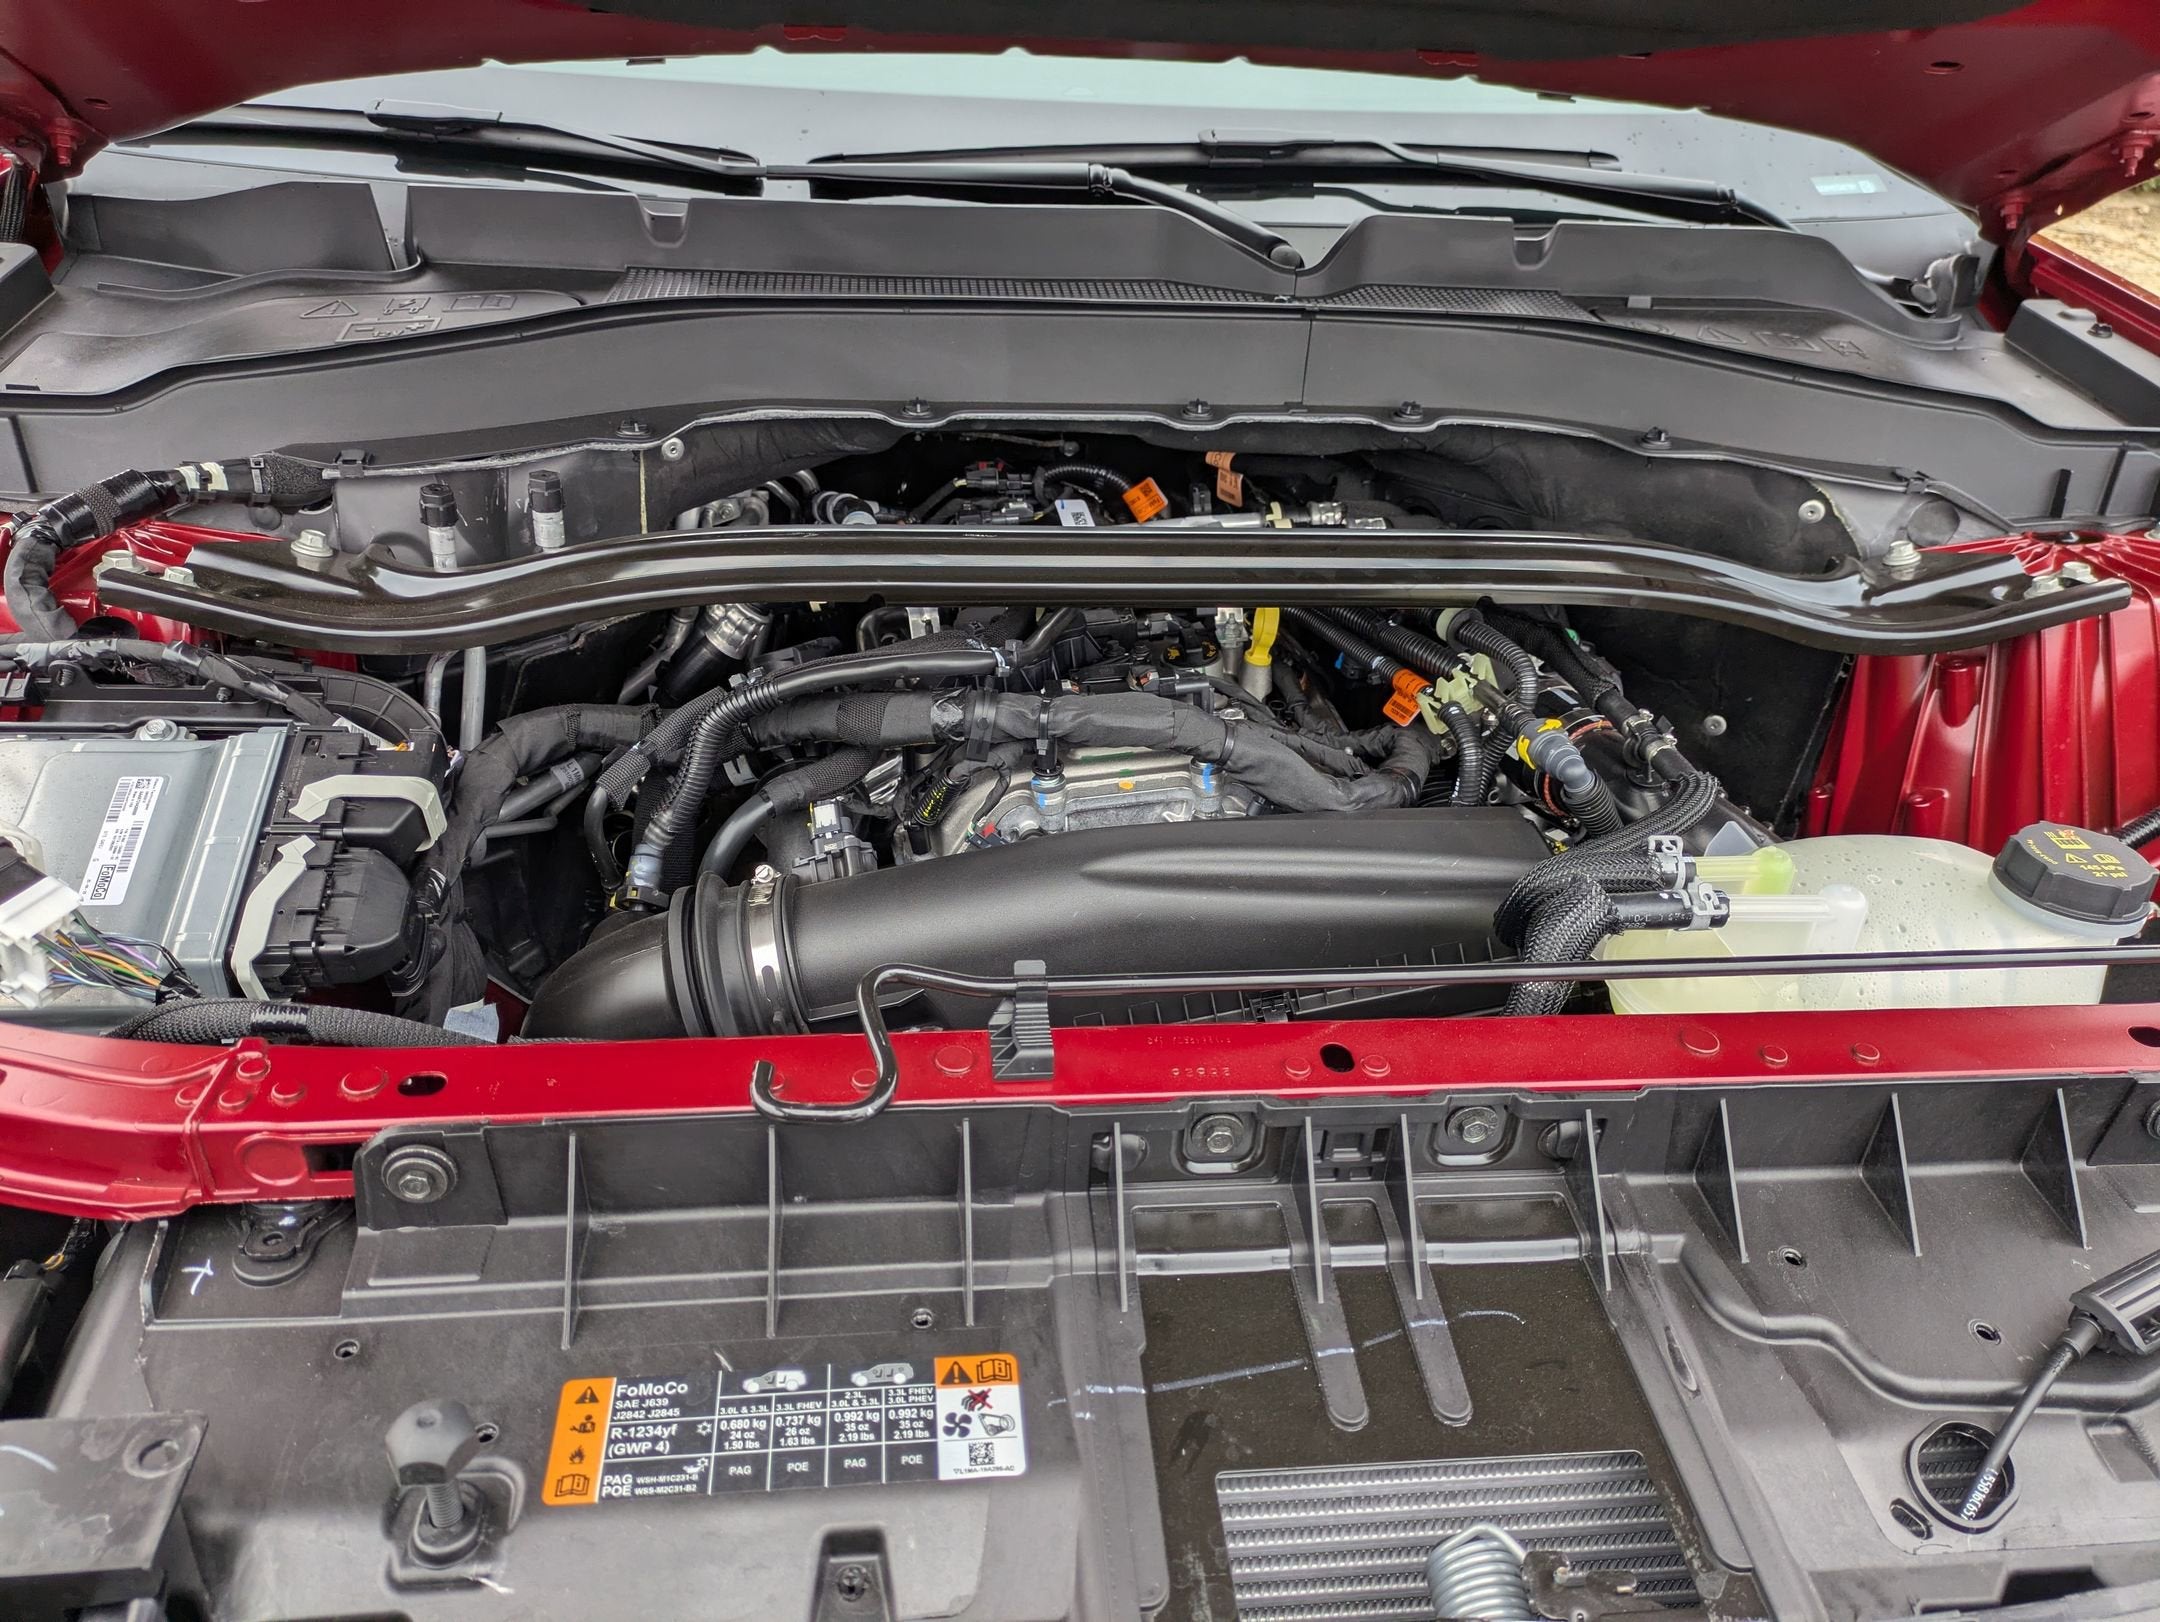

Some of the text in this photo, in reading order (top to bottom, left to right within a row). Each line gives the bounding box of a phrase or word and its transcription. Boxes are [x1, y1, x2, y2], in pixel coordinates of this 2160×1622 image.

[93, 865, 114, 898] FoMoCo
[616, 1381, 688, 1398] FoMoCo
[908, 1387, 934, 1395] FHEV
[615, 1398, 669, 1410] SAE J639
[720, 1404, 769, 1415] 3.0L & 3.3L
[776, 1401, 822, 1412] 3.3L FHEV
[613, 1408, 680, 1420] J2842 J2845
[834, 1410, 880, 1422] 0.992 kg
[888, 1407, 934, 1420] 0.992 kg
[720, 1418, 766, 1431] 0.680 kg
[775, 1414, 822, 1428] 0.737 kg
[899, 1420, 924, 1428] 35 oz
[610, 1424, 678, 1440] R-1234yf
[785, 1428, 811, 1436] 26 oz
[844, 1423, 870, 1432] 35 oz
[730, 1431, 742, 1440] 24
[838, 1432, 876, 1442] 2.19 lbs
[894, 1430, 930, 1440] 2.19 lbs
[724, 1440, 760, 1450] 1.50 lbs
[780, 1436, 816, 1446] 1.63 lbs
[608, 1440, 670, 1458] (GWP 4)
[844, 1458, 867, 1468] PAG
[901, 1454, 924, 1465] POE
[729, 1465, 752, 1476] PAG
[786, 1461, 810, 1472] POE
[604, 1474, 632, 1486] PAG
[602, 1485, 632, 1498] POE
